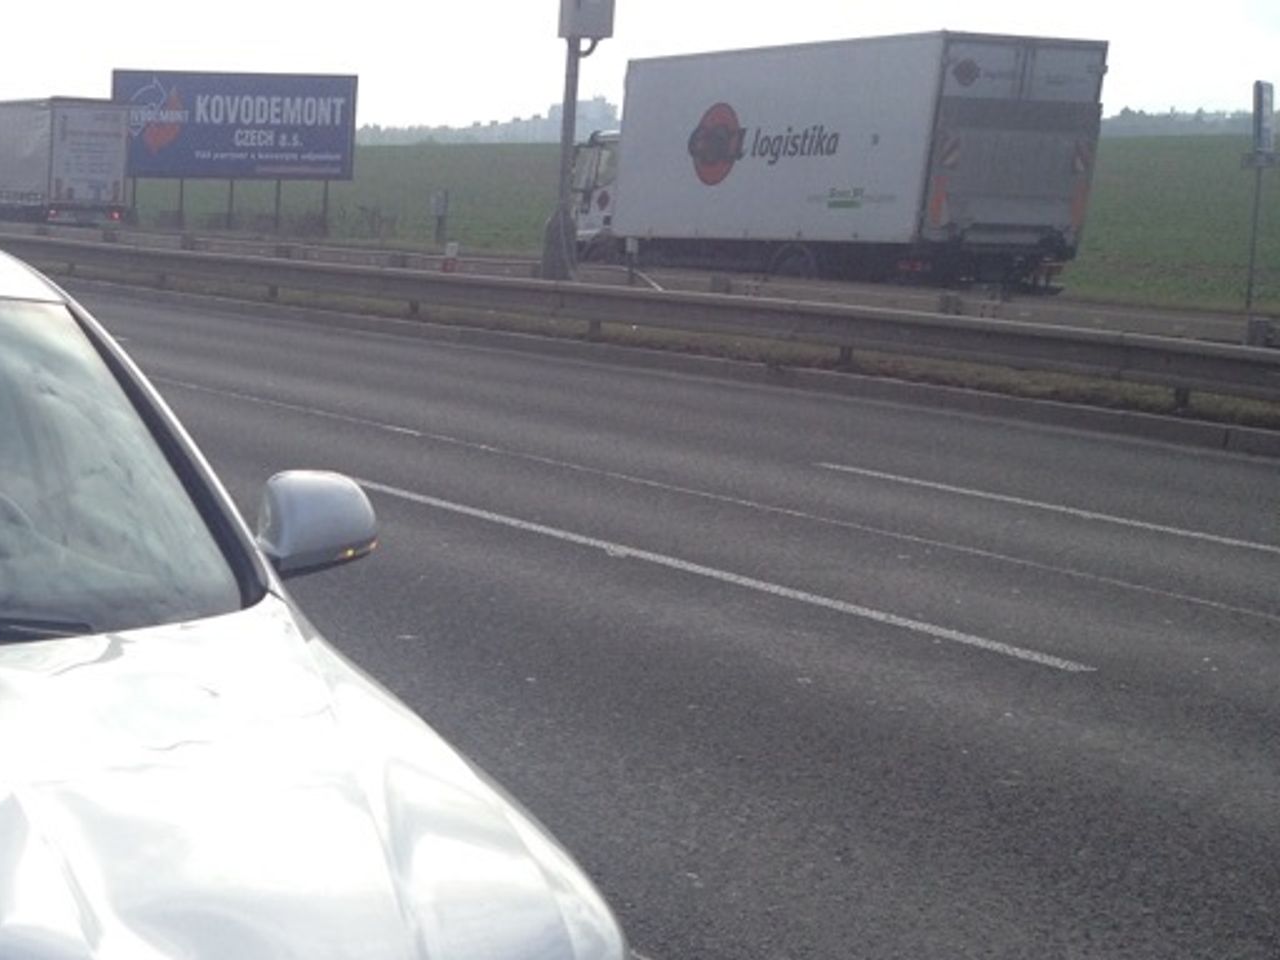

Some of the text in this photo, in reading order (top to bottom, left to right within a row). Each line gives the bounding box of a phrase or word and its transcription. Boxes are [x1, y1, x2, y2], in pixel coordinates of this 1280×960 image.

[195, 94, 345, 126] KOVODEMONT
[234, 128, 274, 147] CZECH
[751, 124, 840, 166] logistika
